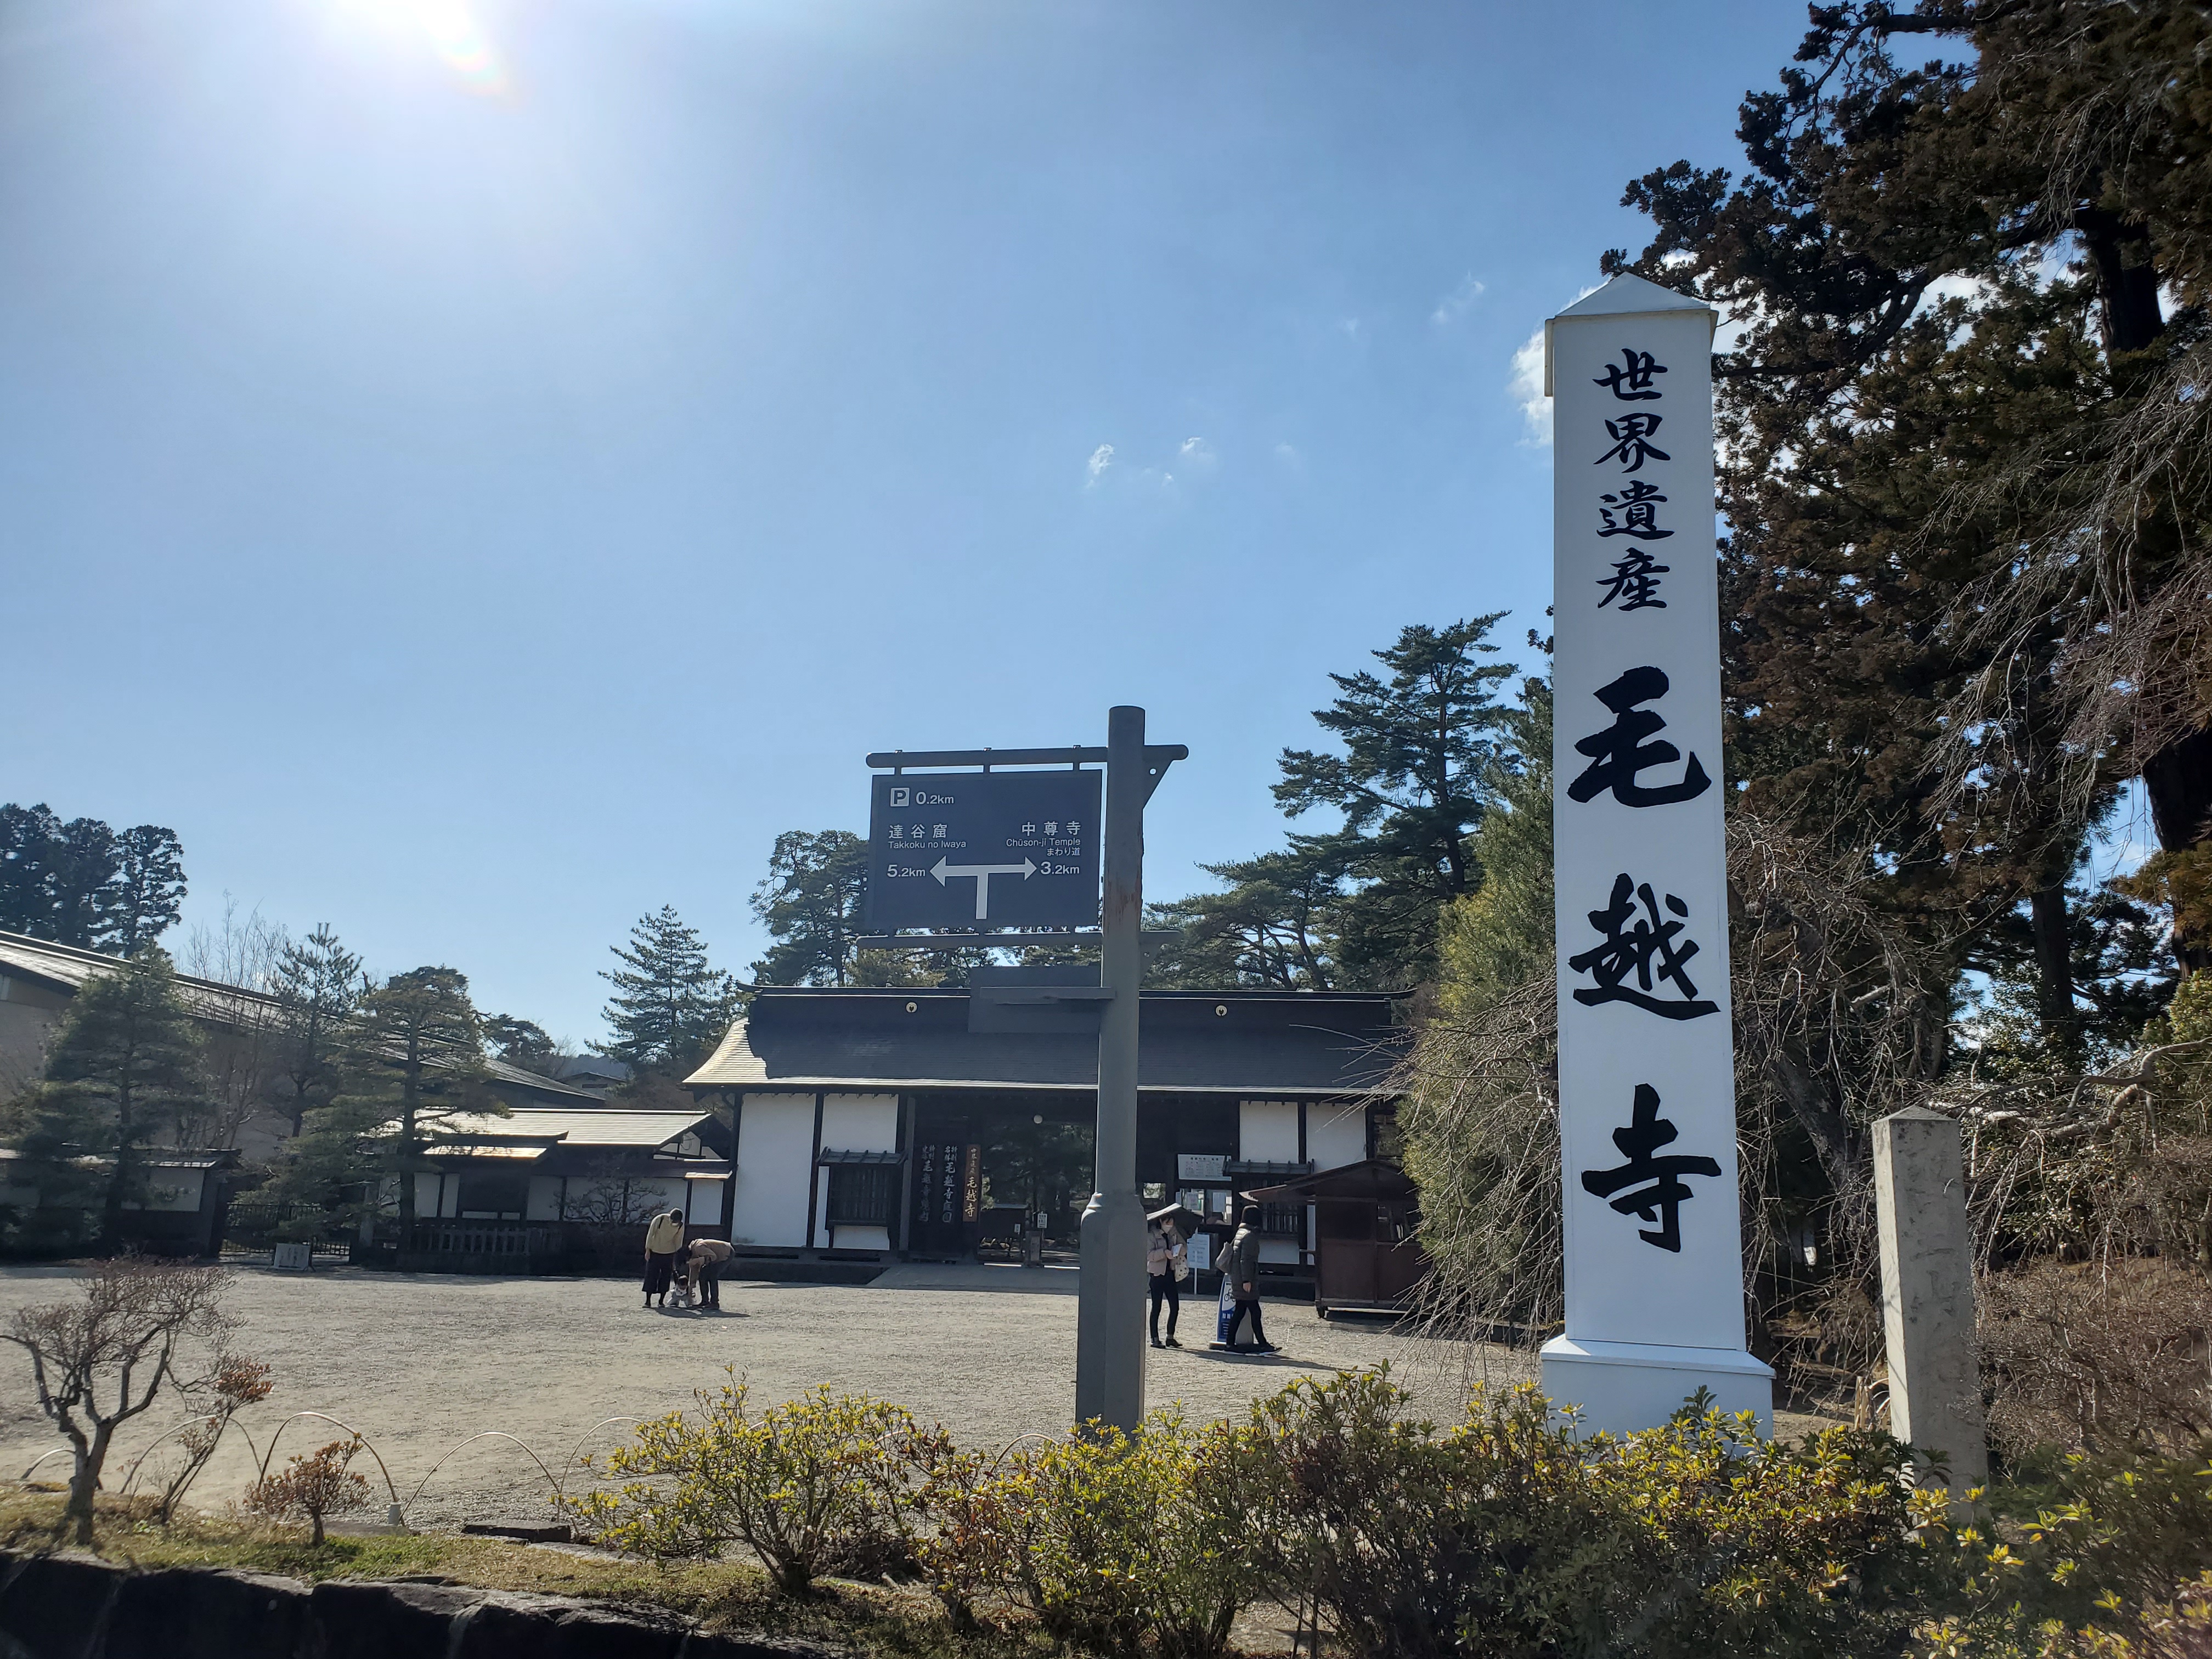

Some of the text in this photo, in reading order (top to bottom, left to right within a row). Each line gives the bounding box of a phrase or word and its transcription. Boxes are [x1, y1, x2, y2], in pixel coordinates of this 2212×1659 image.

[1592, 348, 1675, 612] 世界遺産
[893, 790, 954, 805] P 0.2km
[888, 823, 947, 839] 達谷窟
[1022, 821, 1081, 837] 中尊寺
[888, 840, 925, 849] Takkoku
[941, 840, 966, 849] Iwaya
[1006, 837, 1081, 847] Chūson-ji Temple
[1047, 847, 1081, 856] まわり道
[887, 864, 926, 877] 5.2km
[1040, 861, 1080, 874] 3.2km
[1567, 666, 1722, 1253] 毛越寺
[965, 1176, 977, 1217] 毛越寺
